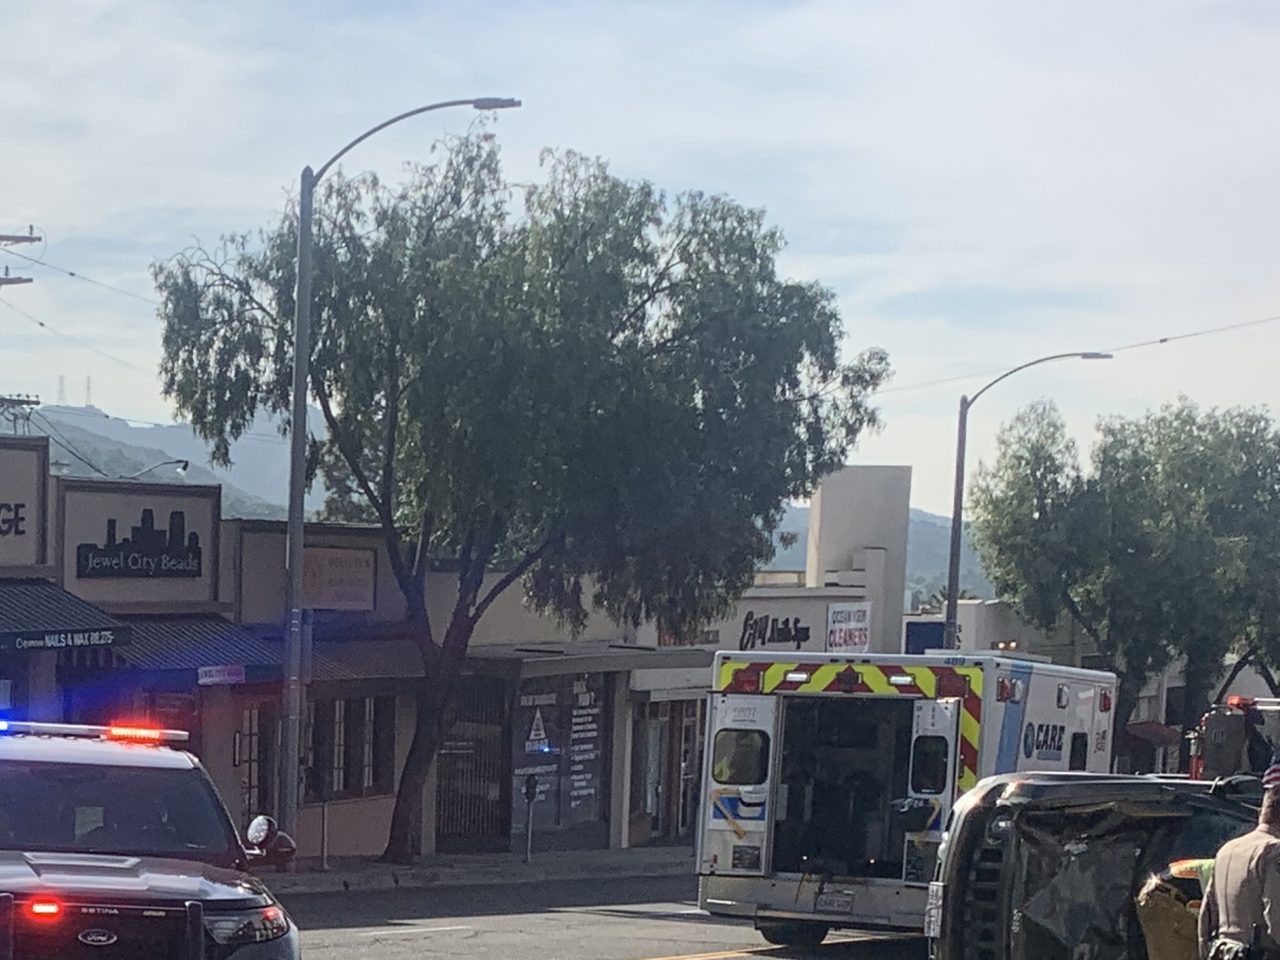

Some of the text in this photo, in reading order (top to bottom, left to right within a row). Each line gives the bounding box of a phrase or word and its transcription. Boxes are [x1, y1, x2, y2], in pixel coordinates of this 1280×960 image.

[86, 554, 199, 574] Jewel City Beads
[44, 633, 67, 648] NAILS
[73, 633, 89, 646] WAX
[828, 627, 868, 648] CLEANERS
[1035, 724, 1065, 752] CARE
